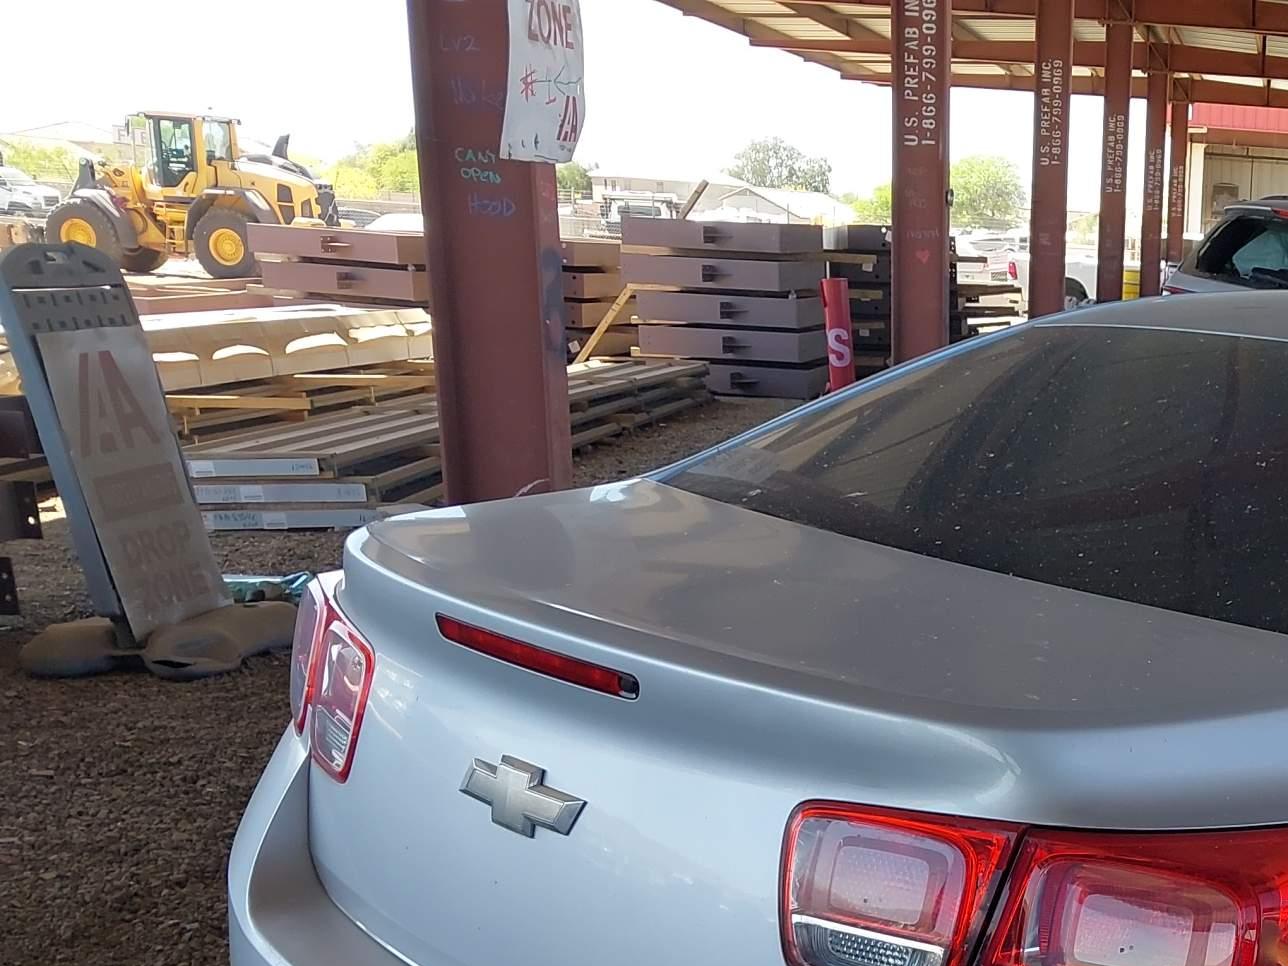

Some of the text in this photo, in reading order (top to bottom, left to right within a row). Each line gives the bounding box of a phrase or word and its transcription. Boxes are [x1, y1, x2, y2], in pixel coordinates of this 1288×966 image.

[526, 0, 575, 50] ZONE
[904, 27, 920, 101] PREFAB
[904, 112, 919, 146] U.S.
[1040, 58, 1053, 166] U.S. PREFAB INC.
[1051, 59, 1064, 166] 1-866-799-0969
